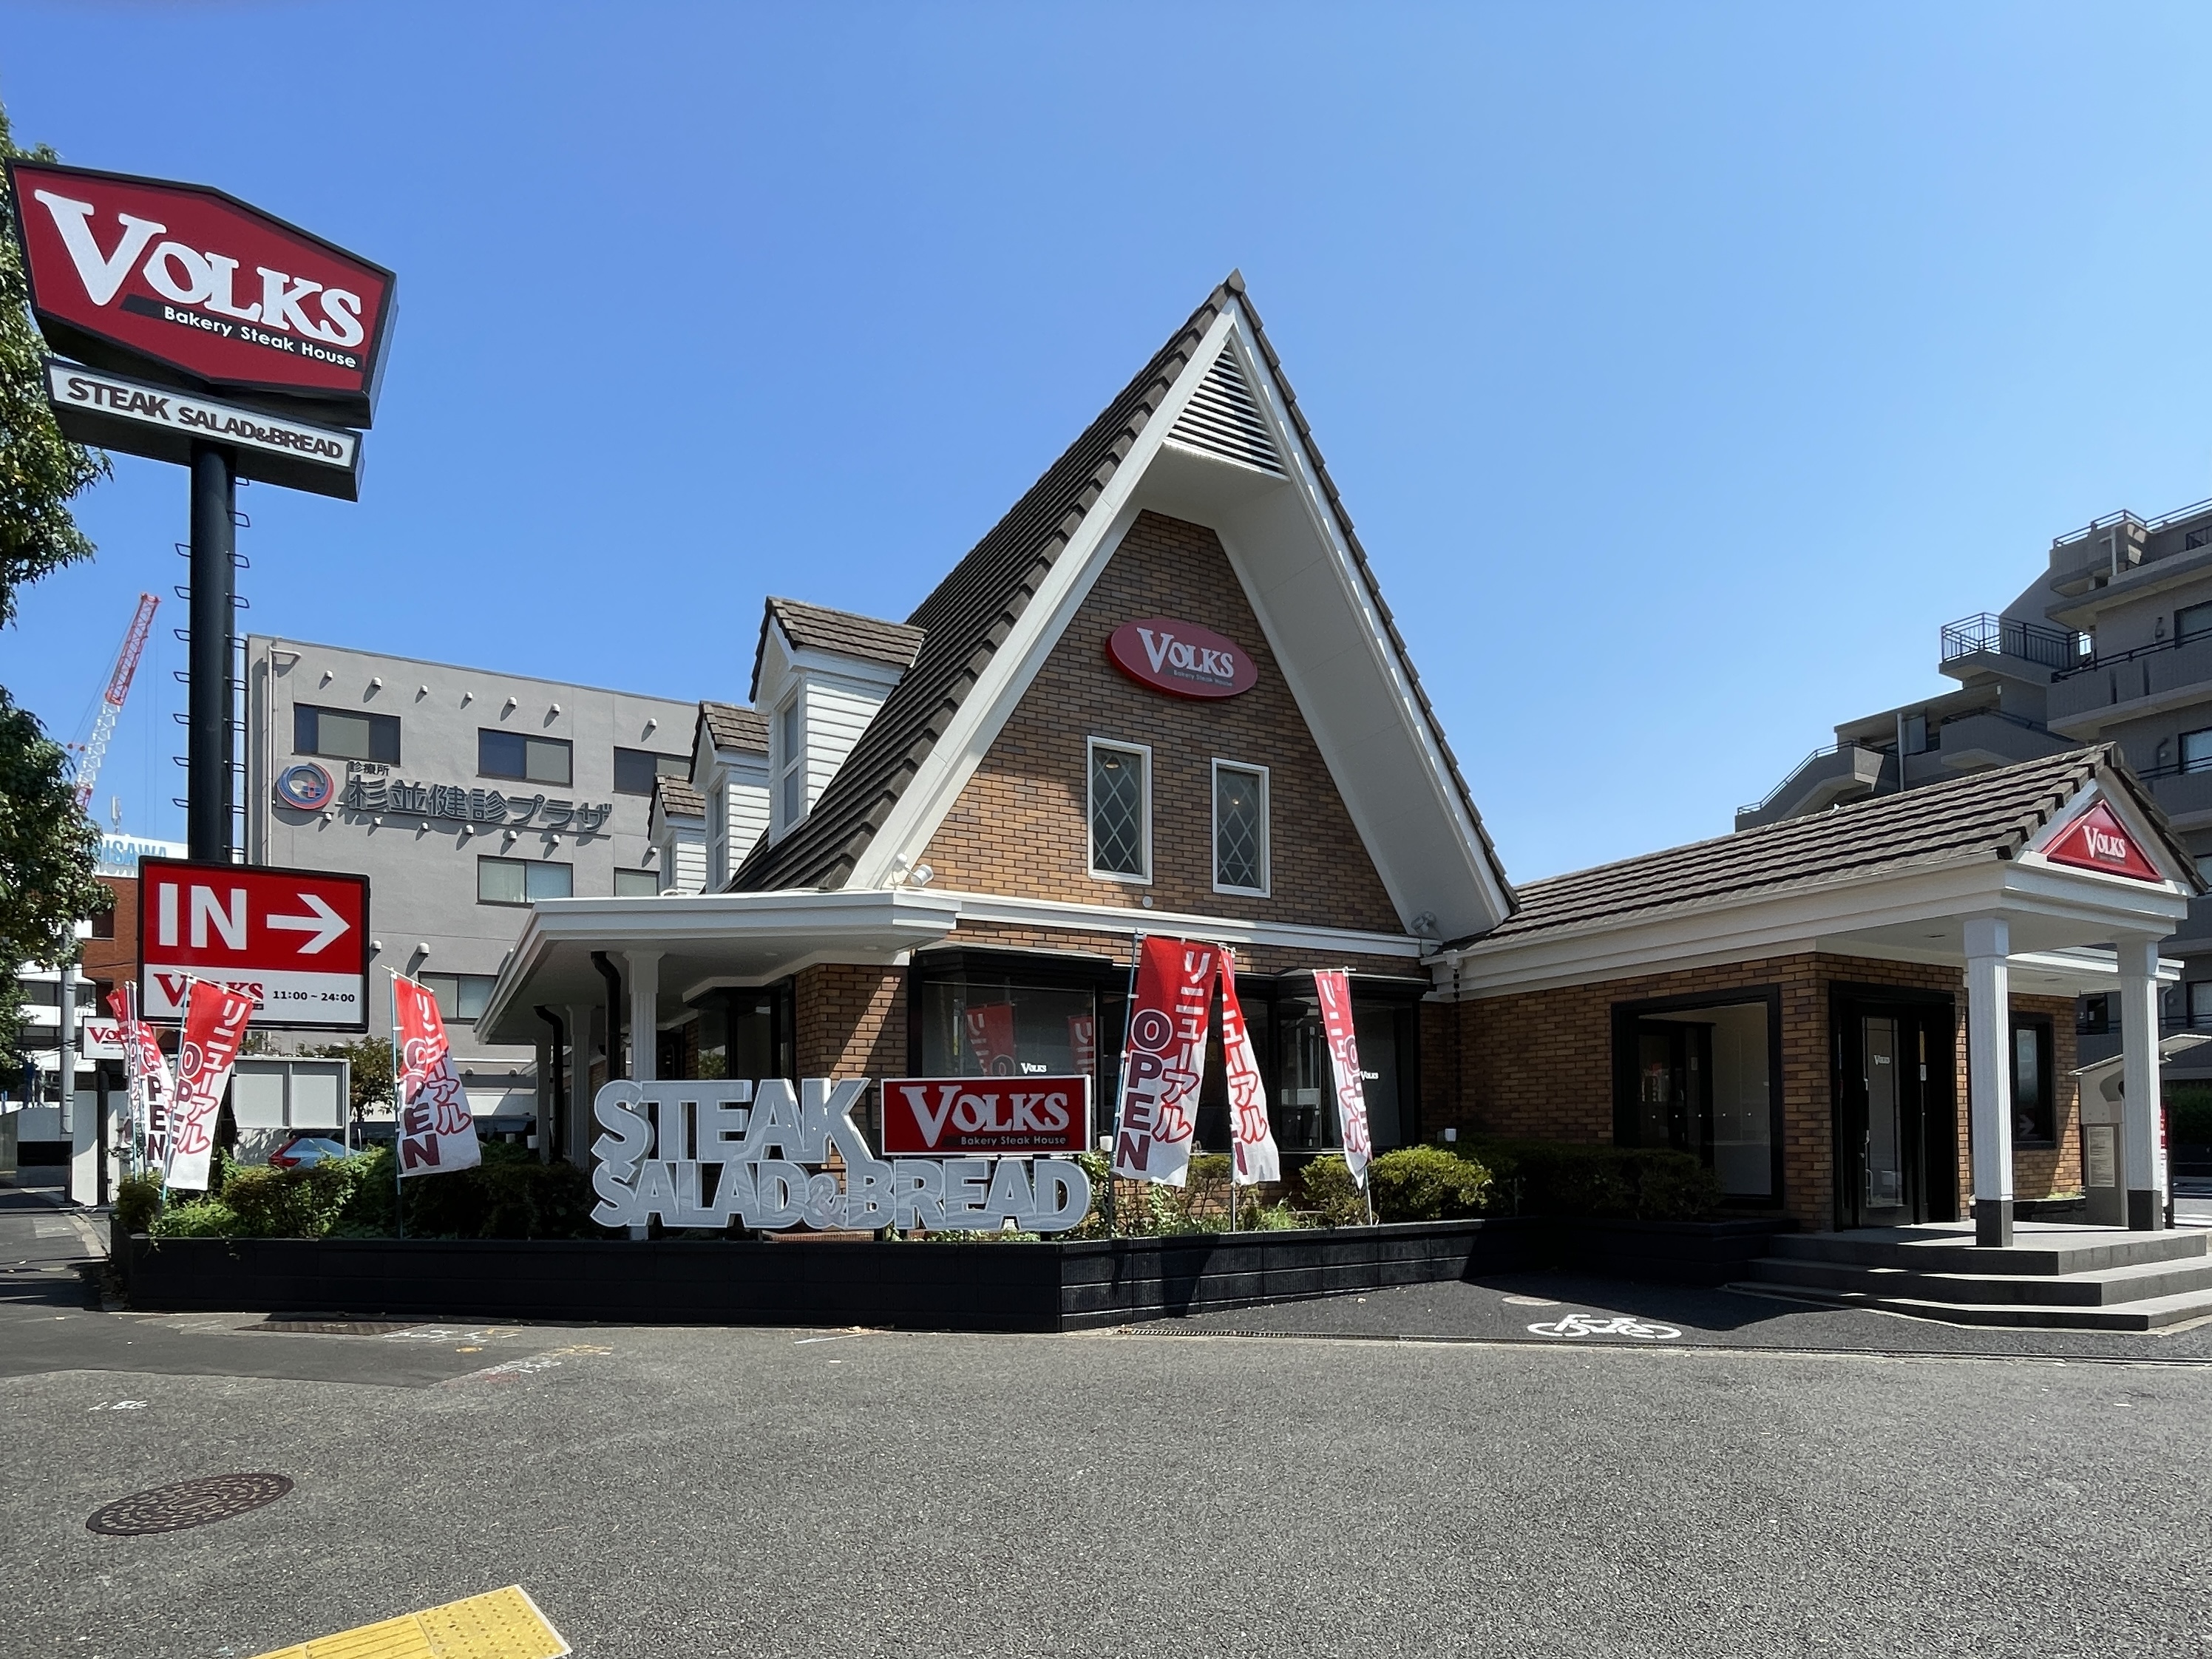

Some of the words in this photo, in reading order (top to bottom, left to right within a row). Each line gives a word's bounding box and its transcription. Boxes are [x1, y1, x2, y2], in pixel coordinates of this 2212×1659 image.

[34, 189, 364, 348] VOLKS
[164, 305, 233, 337] Bakery
[240, 325, 295, 353] Steak
[302, 342, 356, 369] House
[67, 378, 171, 421] STEAK
[178, 407, 343, 460] SALAD&BREAD
[1136, 627, 1234, 678] VOLKS
[347, 773, 613, 832] 杉並健診プラザ
[2082, 825, 2126, 858] VOLKS
[158, 883, 247, 951] IN
[153, 973, 264, 1007] VKS
[273, 990, 308, 1000] 11:00
[322, 993, 355, 1002] 24:00
[177, 999, 247, 1155] リニューアル
[1151, 951, 1211, 1144] リニューアル
[591, 1078, 875, 1164] STEAK
[900, 1085, 1070, 1148] VOLKS
[1116, 1008, 1174, 1172] OPEN
[961, 1136, 997, 1147] Bakery
[1001, 1136, 1031, 1145] Steak
[1034, 1136, 1066, 1145] House
[591, 1158, 1091, 1232] SALAD&BREAD
